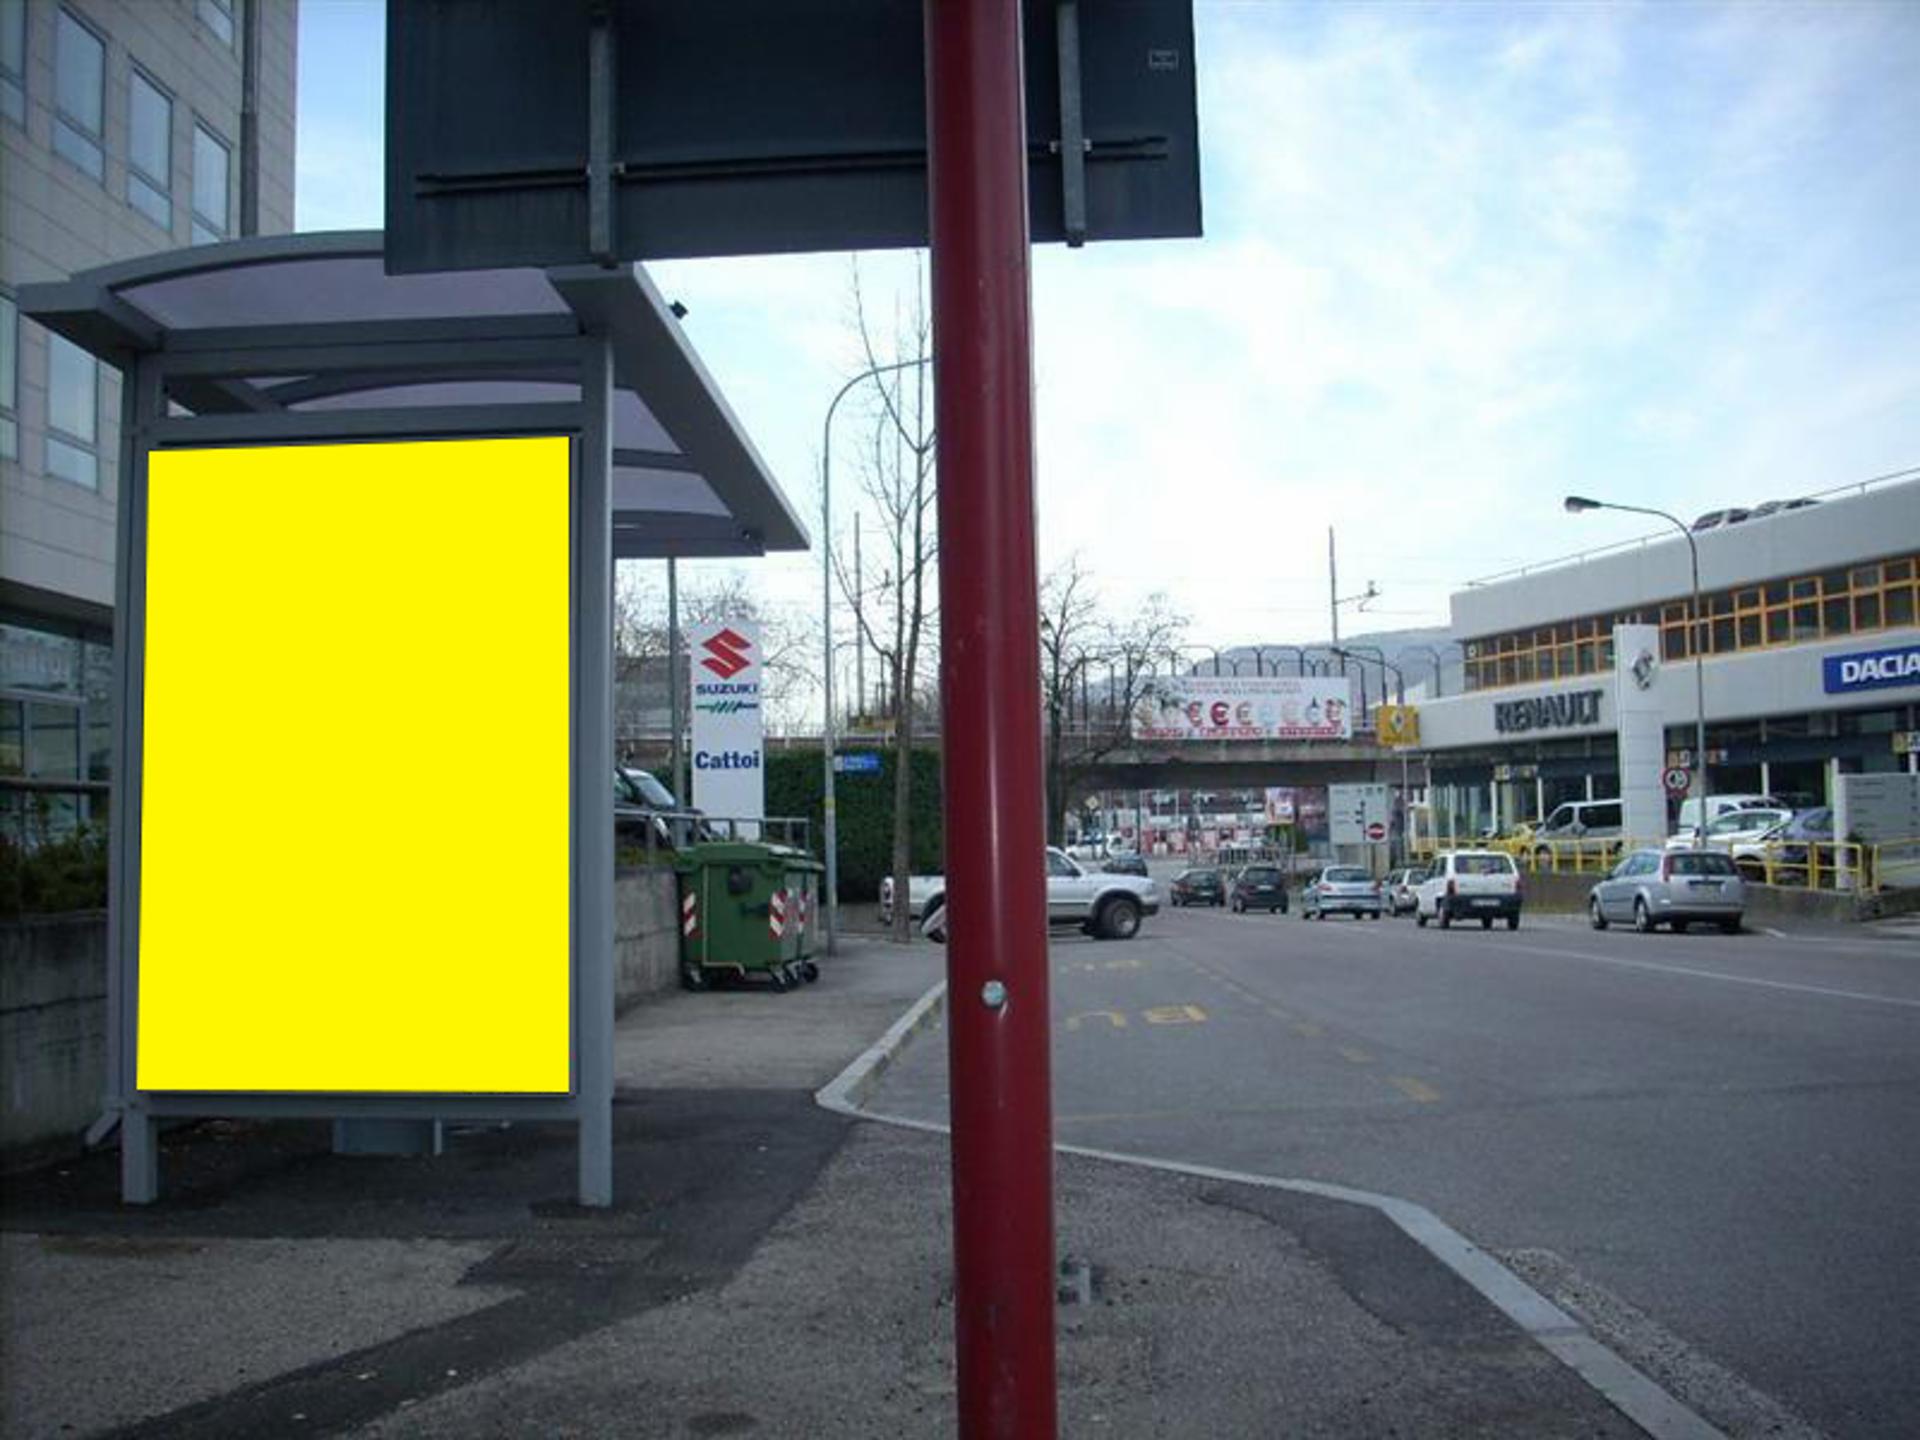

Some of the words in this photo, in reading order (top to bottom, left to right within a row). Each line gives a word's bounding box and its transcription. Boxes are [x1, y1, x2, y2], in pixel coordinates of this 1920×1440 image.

[1842, 653, 1920, 682] DACIA
[695, 683, 758, 694] SUZUKI
[1494, 689, 1604, 733] RENAULT
[695, 750, 759, 768] Cattoi
